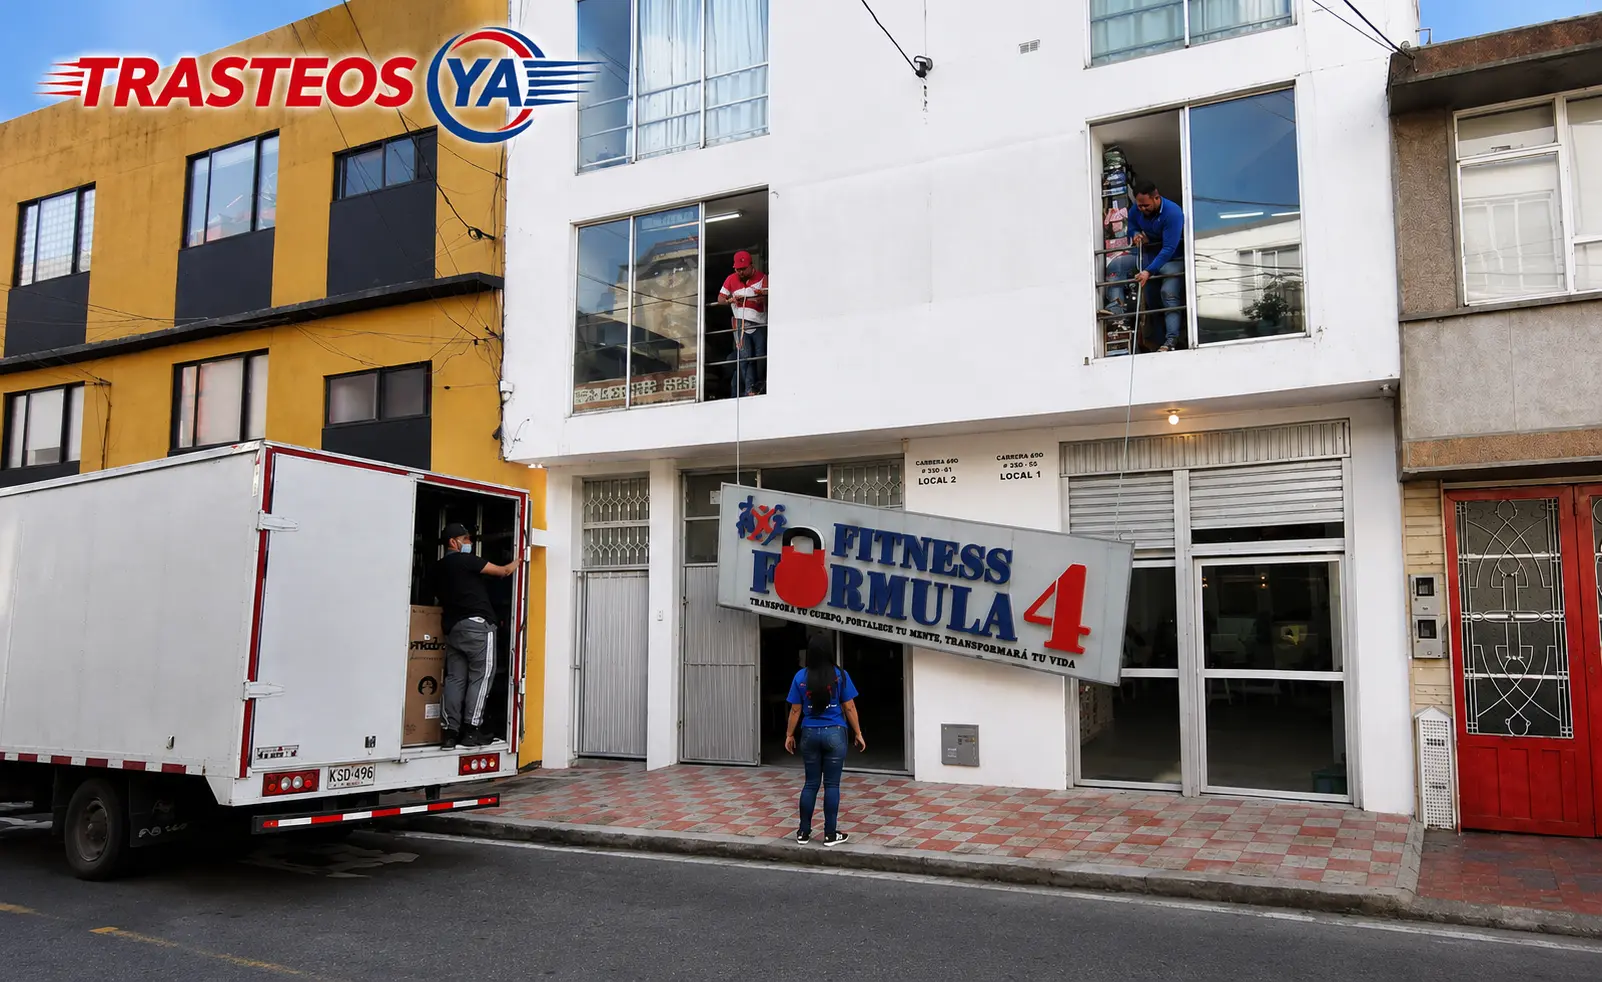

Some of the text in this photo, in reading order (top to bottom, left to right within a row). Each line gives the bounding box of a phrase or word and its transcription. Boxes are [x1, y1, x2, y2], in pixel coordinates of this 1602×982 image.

[918, 476, 948, 485] LOCAL
[1000, 470, 1041, 480] LOCAL 1
[831, 522, 1014, 585] FITNESS
[809, 609, 844, 625] CUERPO,
[896, 626, 908, 636] TU
[909, 629, 943, 644] MENTE,
[1031, 652, 1047, 663] TU
[1050, 655, 1076, 669] VIDA
[1023, 563, 1092, 655] 4
